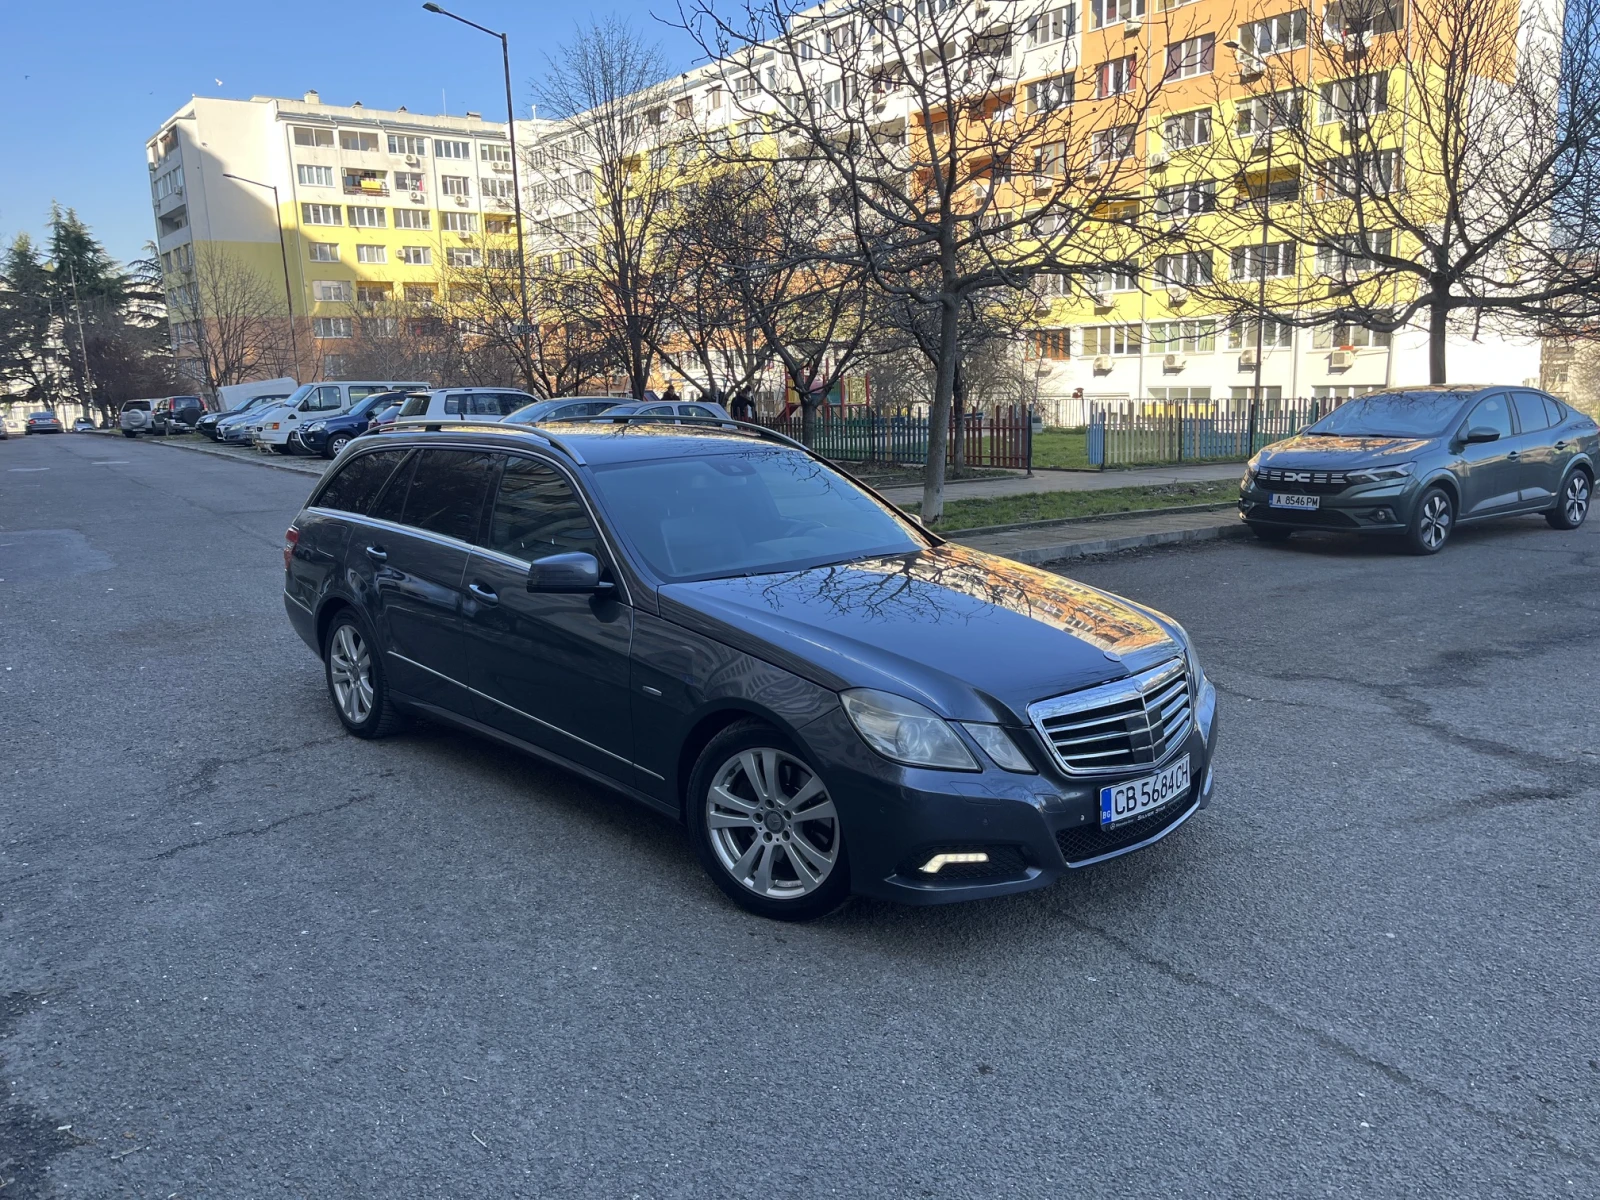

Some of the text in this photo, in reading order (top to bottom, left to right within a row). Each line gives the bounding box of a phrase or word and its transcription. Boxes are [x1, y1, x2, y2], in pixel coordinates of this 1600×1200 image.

[1276, 496, 1318, 506] A 8546 PM
[1114, 785, 1138, 816] CB
[1140, 770, 1174, 807] 5684
[1176, 760, 1188, 790] CH
[1102, 810, 1111, 820] BG
